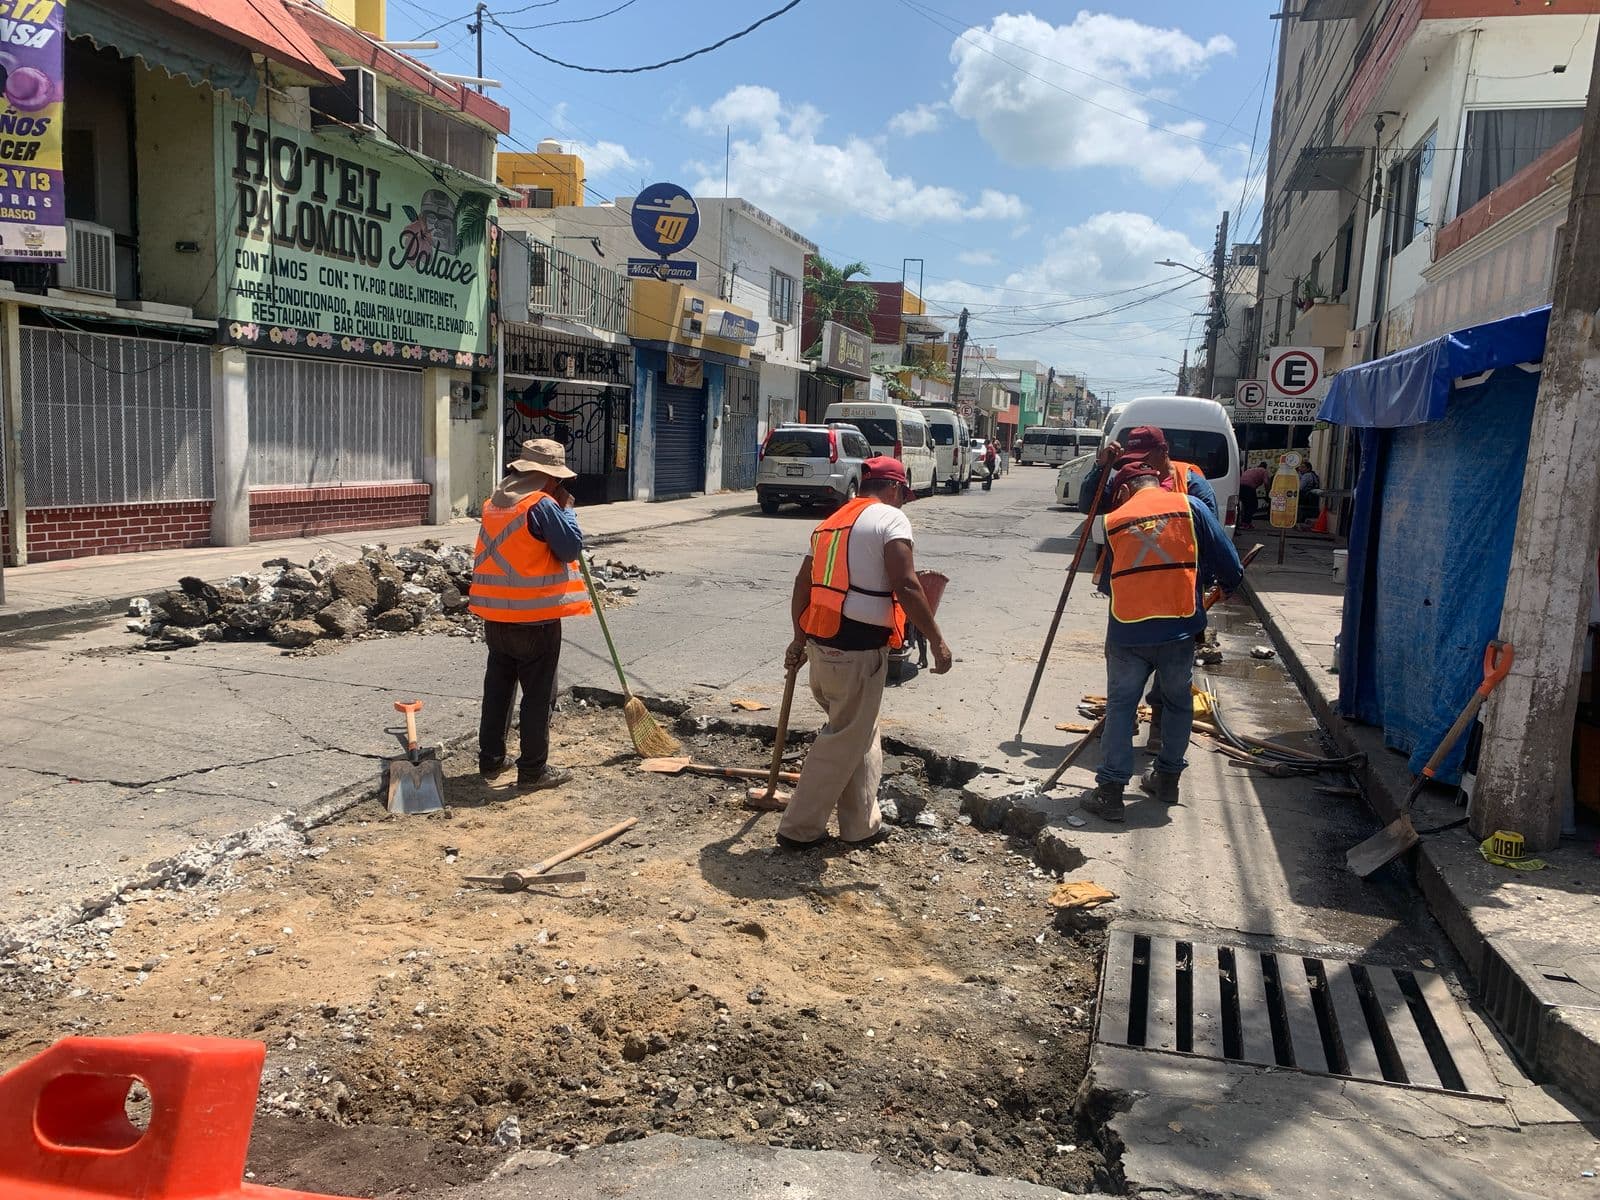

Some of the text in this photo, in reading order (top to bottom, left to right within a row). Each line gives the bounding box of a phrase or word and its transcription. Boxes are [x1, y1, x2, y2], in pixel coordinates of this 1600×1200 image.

[0, 139, 41, 161] CER
[11, 170, 27, 188] Y
[30, 172, 51, 192] 13
[231, 121, 391, 222] HOTEL
[0, 207, 36, 221] BASCO
[235, 182, 382, 268] PALOMINO
[235, 249, 307, 281] CONTAMOS
[319, 267, 348, 290] CON:
[389, 230, 478, 285] Palace
[251, 302, 321, 329] RESTAURANT
[334, 315, 354, 334] BAR
[1284, 360, 1307, 386] E
[1246, 387, 1258, 402] E
[1268, 400, 1316, 409] EXCLUSIVO
